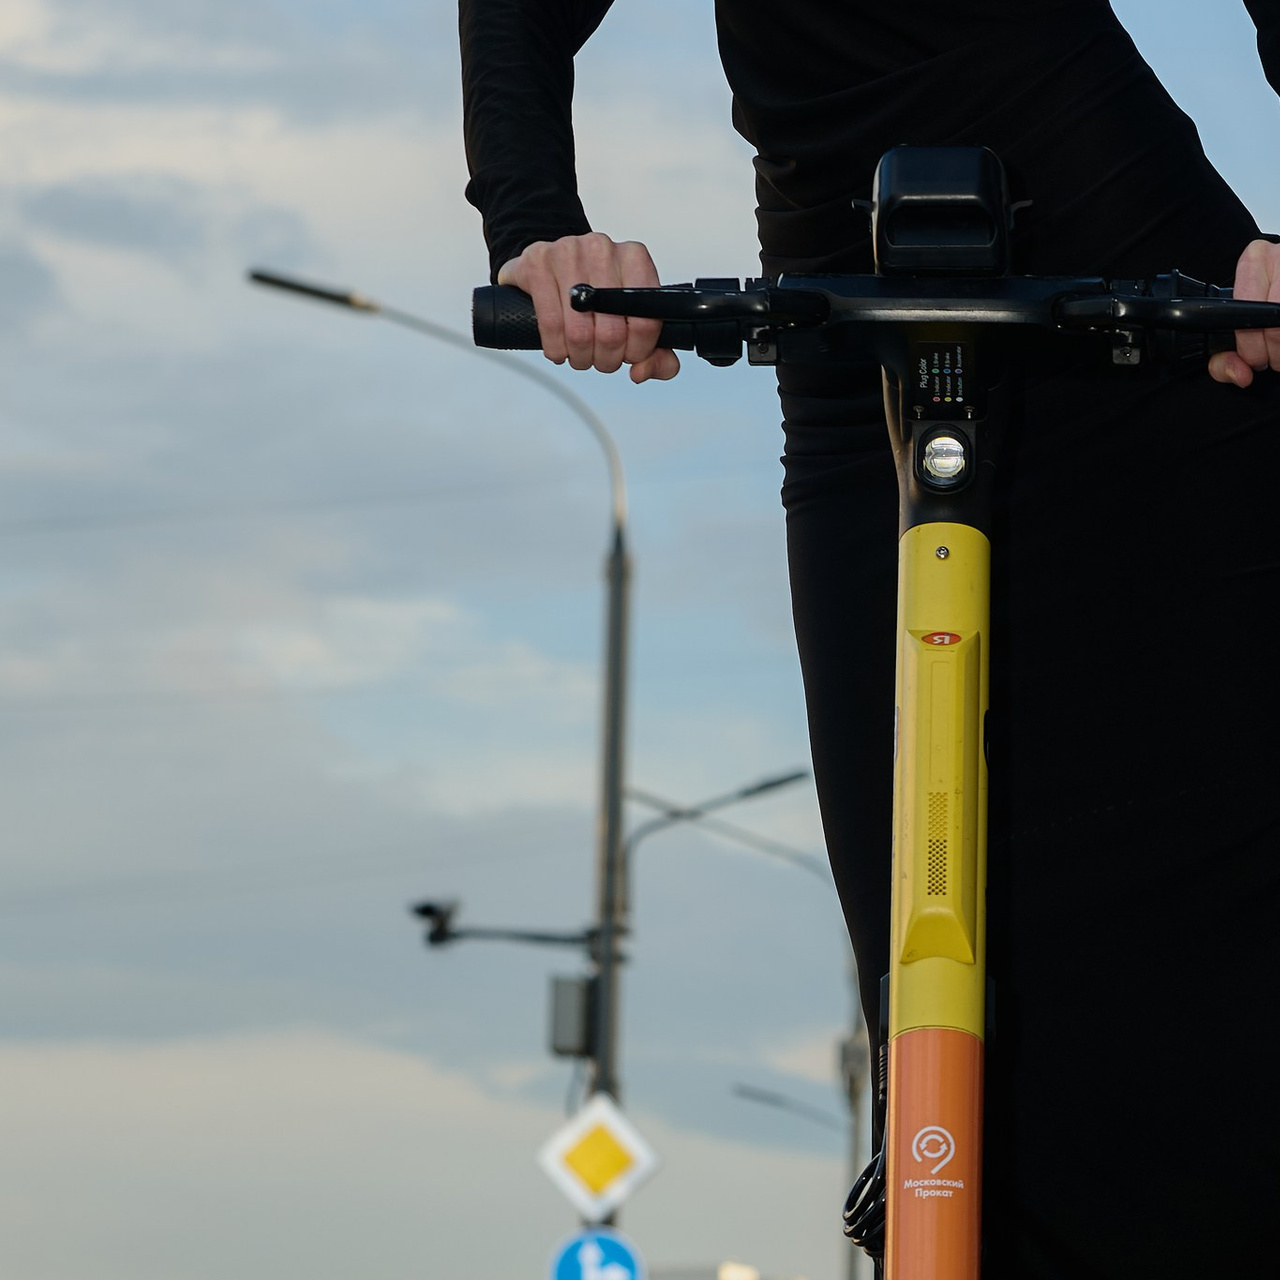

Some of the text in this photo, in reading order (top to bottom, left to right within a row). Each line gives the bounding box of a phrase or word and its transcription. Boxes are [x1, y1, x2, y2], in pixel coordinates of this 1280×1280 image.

[919, 358, 929, 388] Plug Color
[904, 1179, 964, 1189] Московский
[915, 1188, 953, 1199] Прокат
